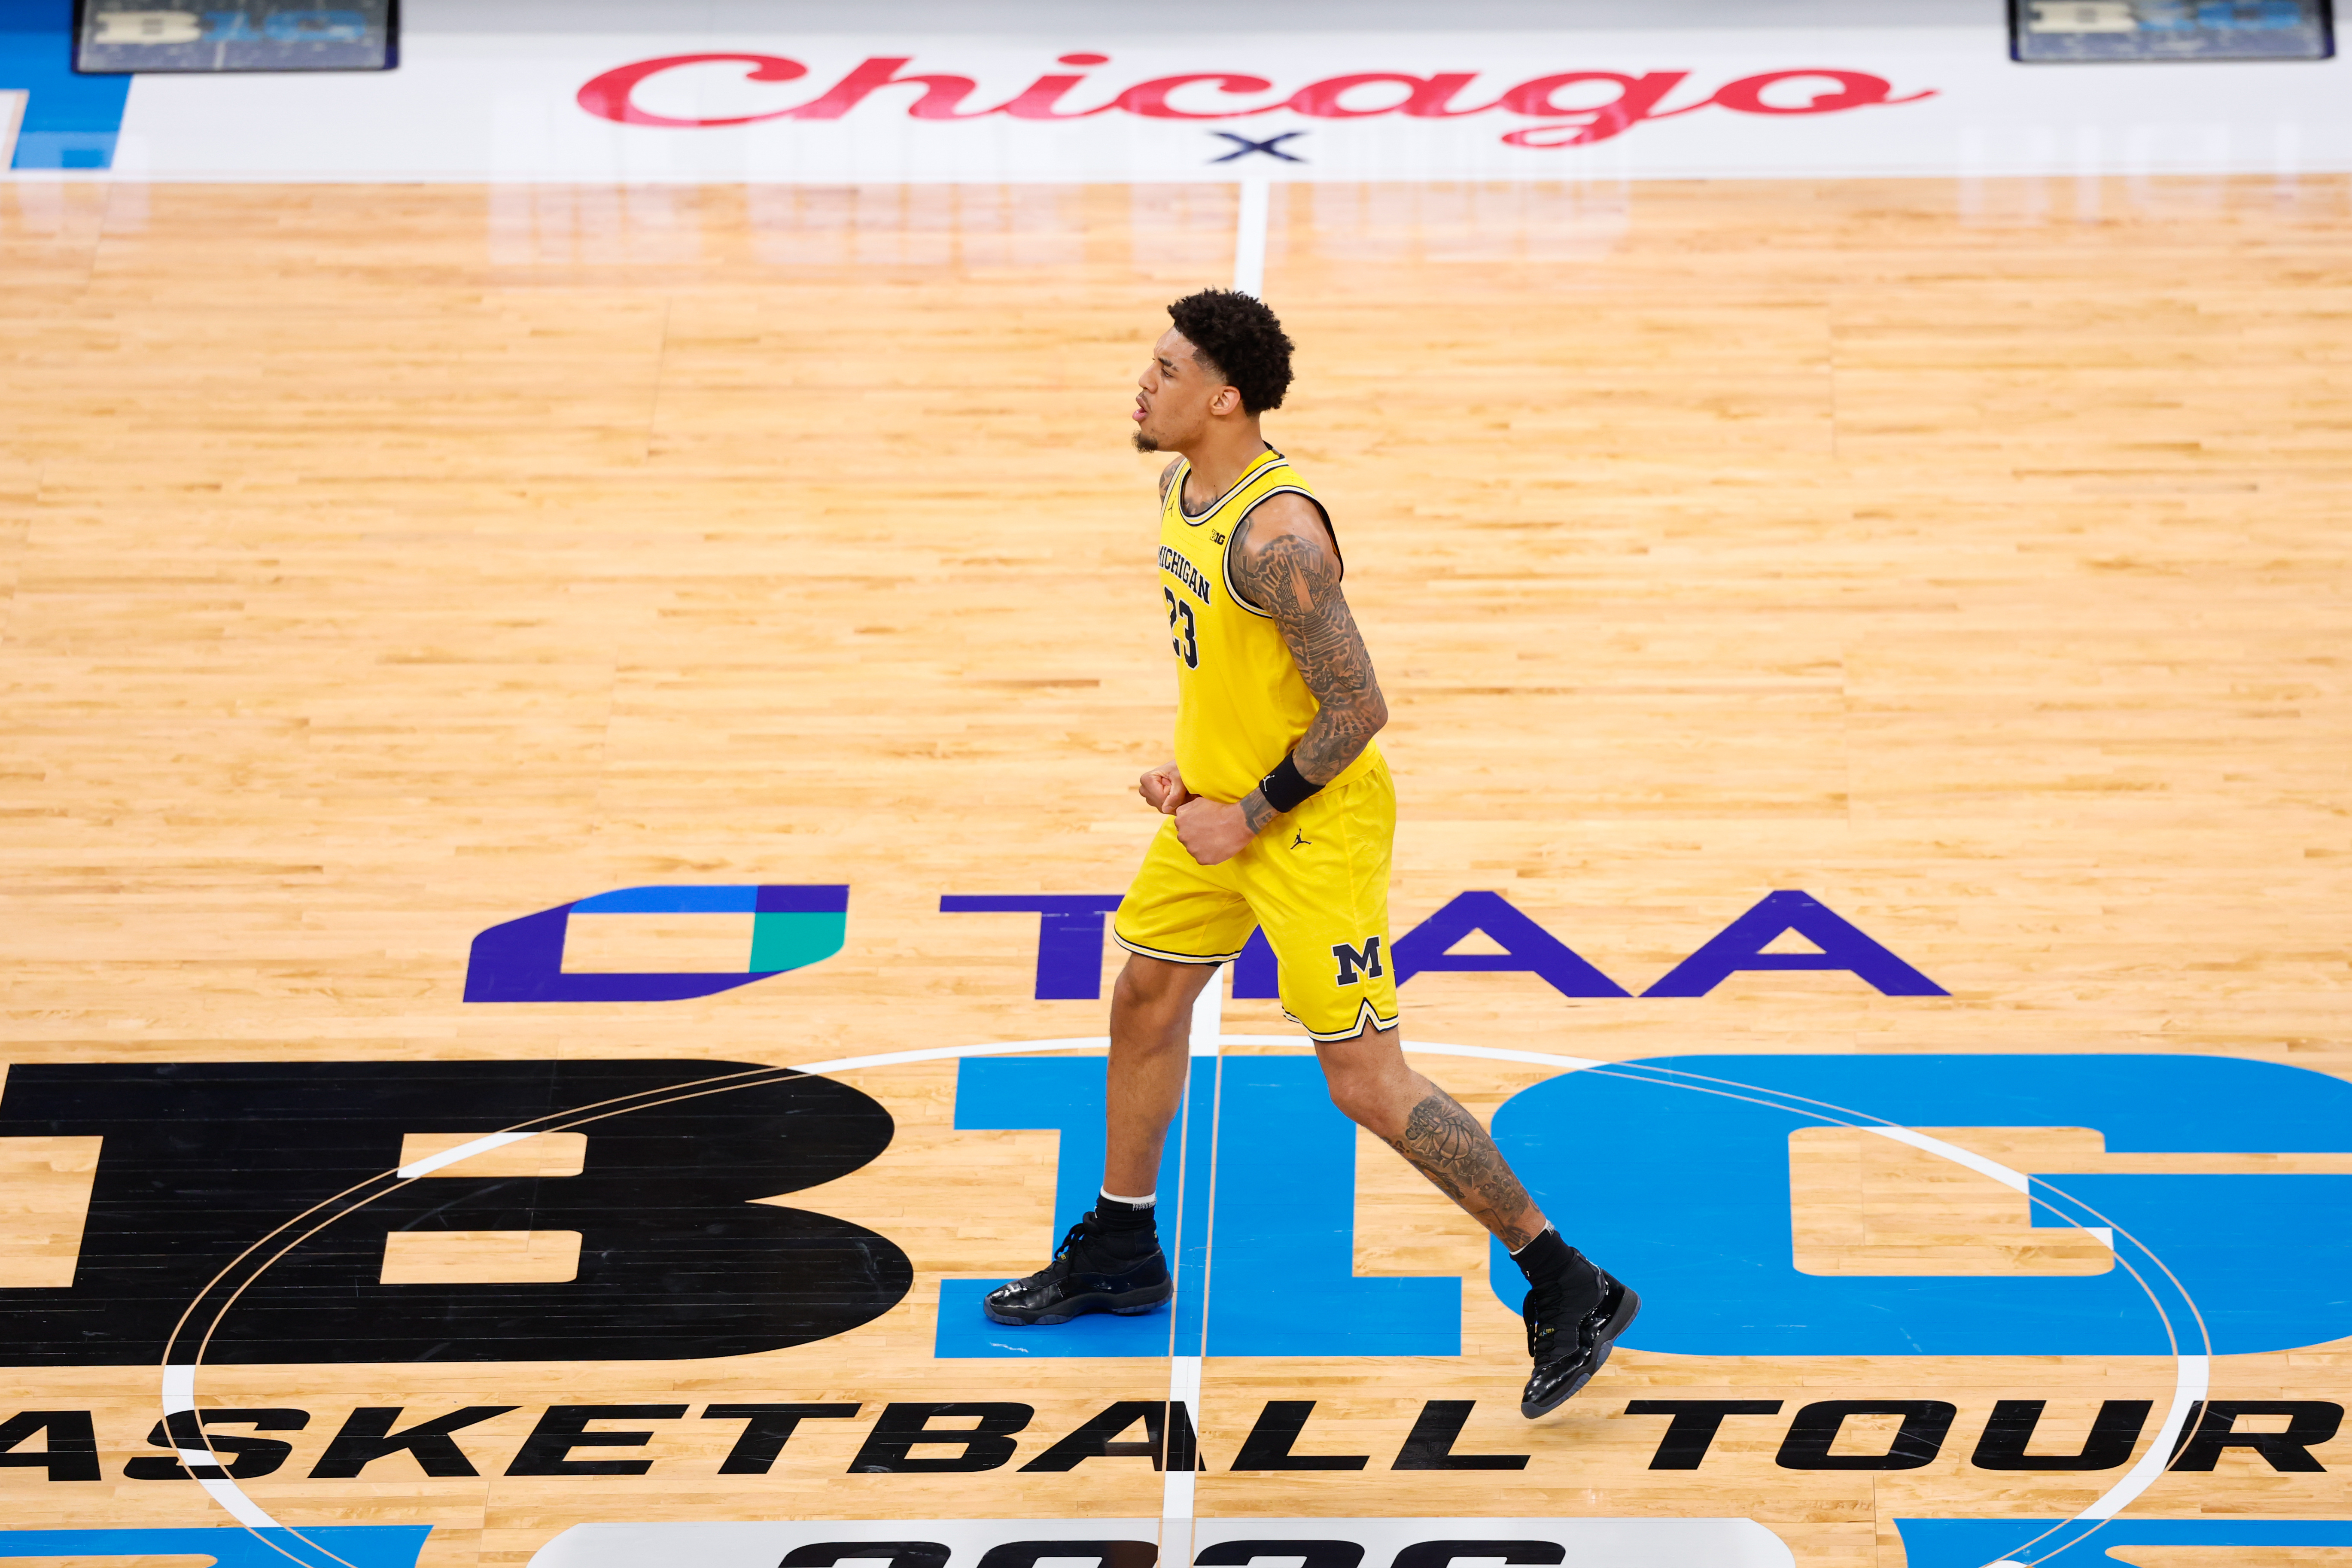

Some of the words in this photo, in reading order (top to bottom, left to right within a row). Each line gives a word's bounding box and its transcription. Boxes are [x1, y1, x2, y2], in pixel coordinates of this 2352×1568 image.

[576, 52, 1940, 149] Chicago
[1164, 585, 1199, 670] 23
[1331, 935, 1383, 987] M
[1623, 1400, 2344, 1472] TOUR
